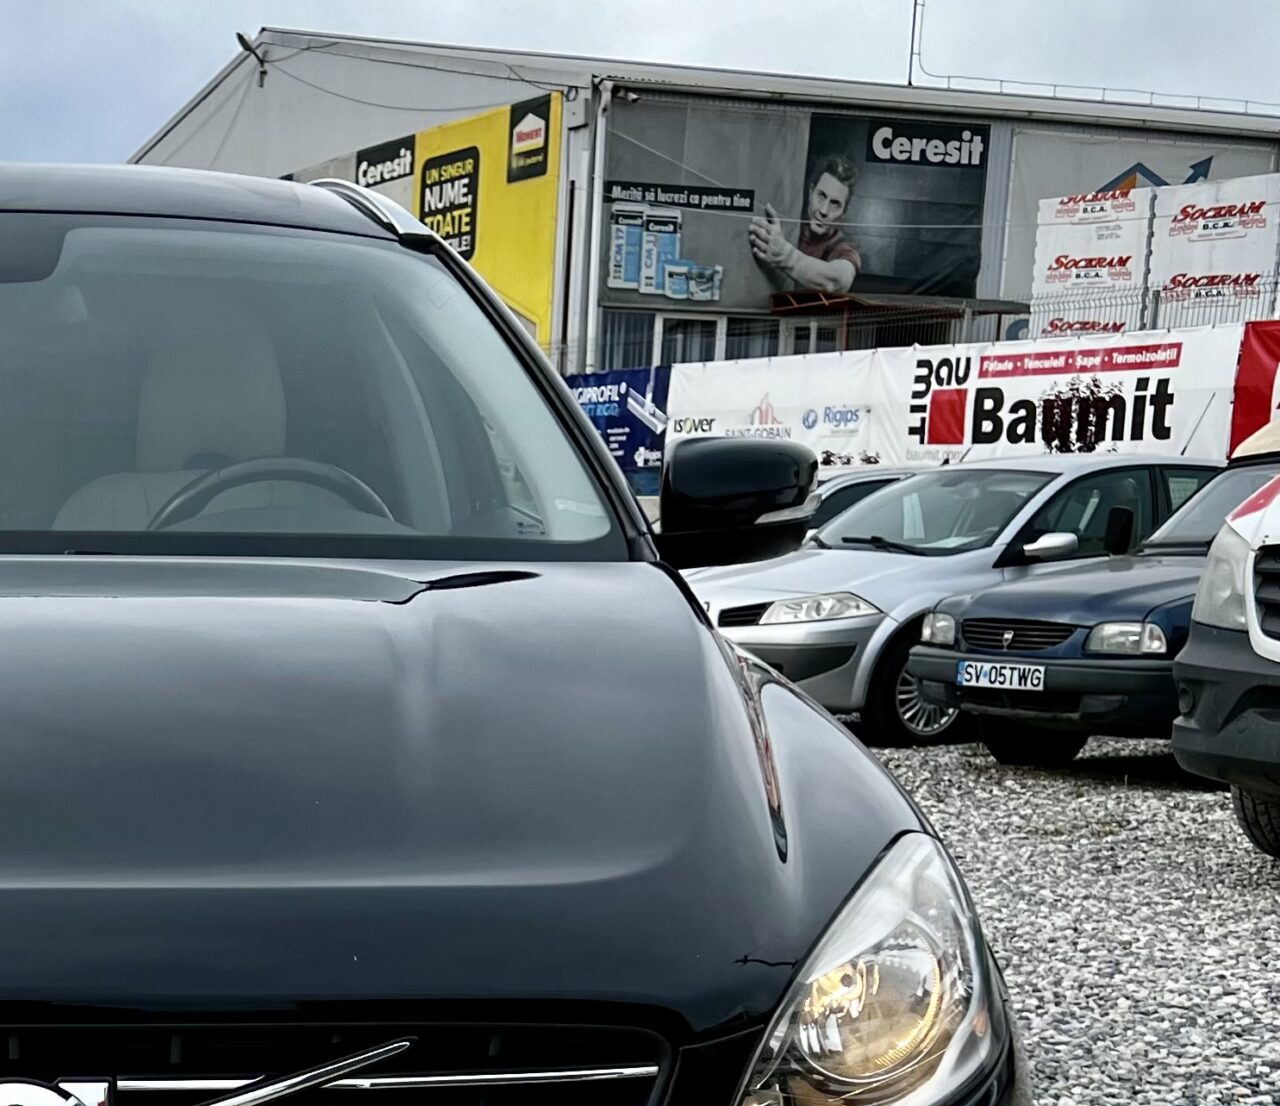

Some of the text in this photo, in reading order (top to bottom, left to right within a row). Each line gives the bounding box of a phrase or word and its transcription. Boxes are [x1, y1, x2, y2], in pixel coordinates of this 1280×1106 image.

[872, 126, 984, 165] Ceresit
[358, 147, 412, 187] Ceresit
[426, 158, 475, 184] UN SINGUR
[424, 177, 472, 212] NUME,
[658, 186, 688, 204] lucrezi
[823, 404, 860, 427] Rigips
[964, 663, 1042, 688] SV 05TWG
